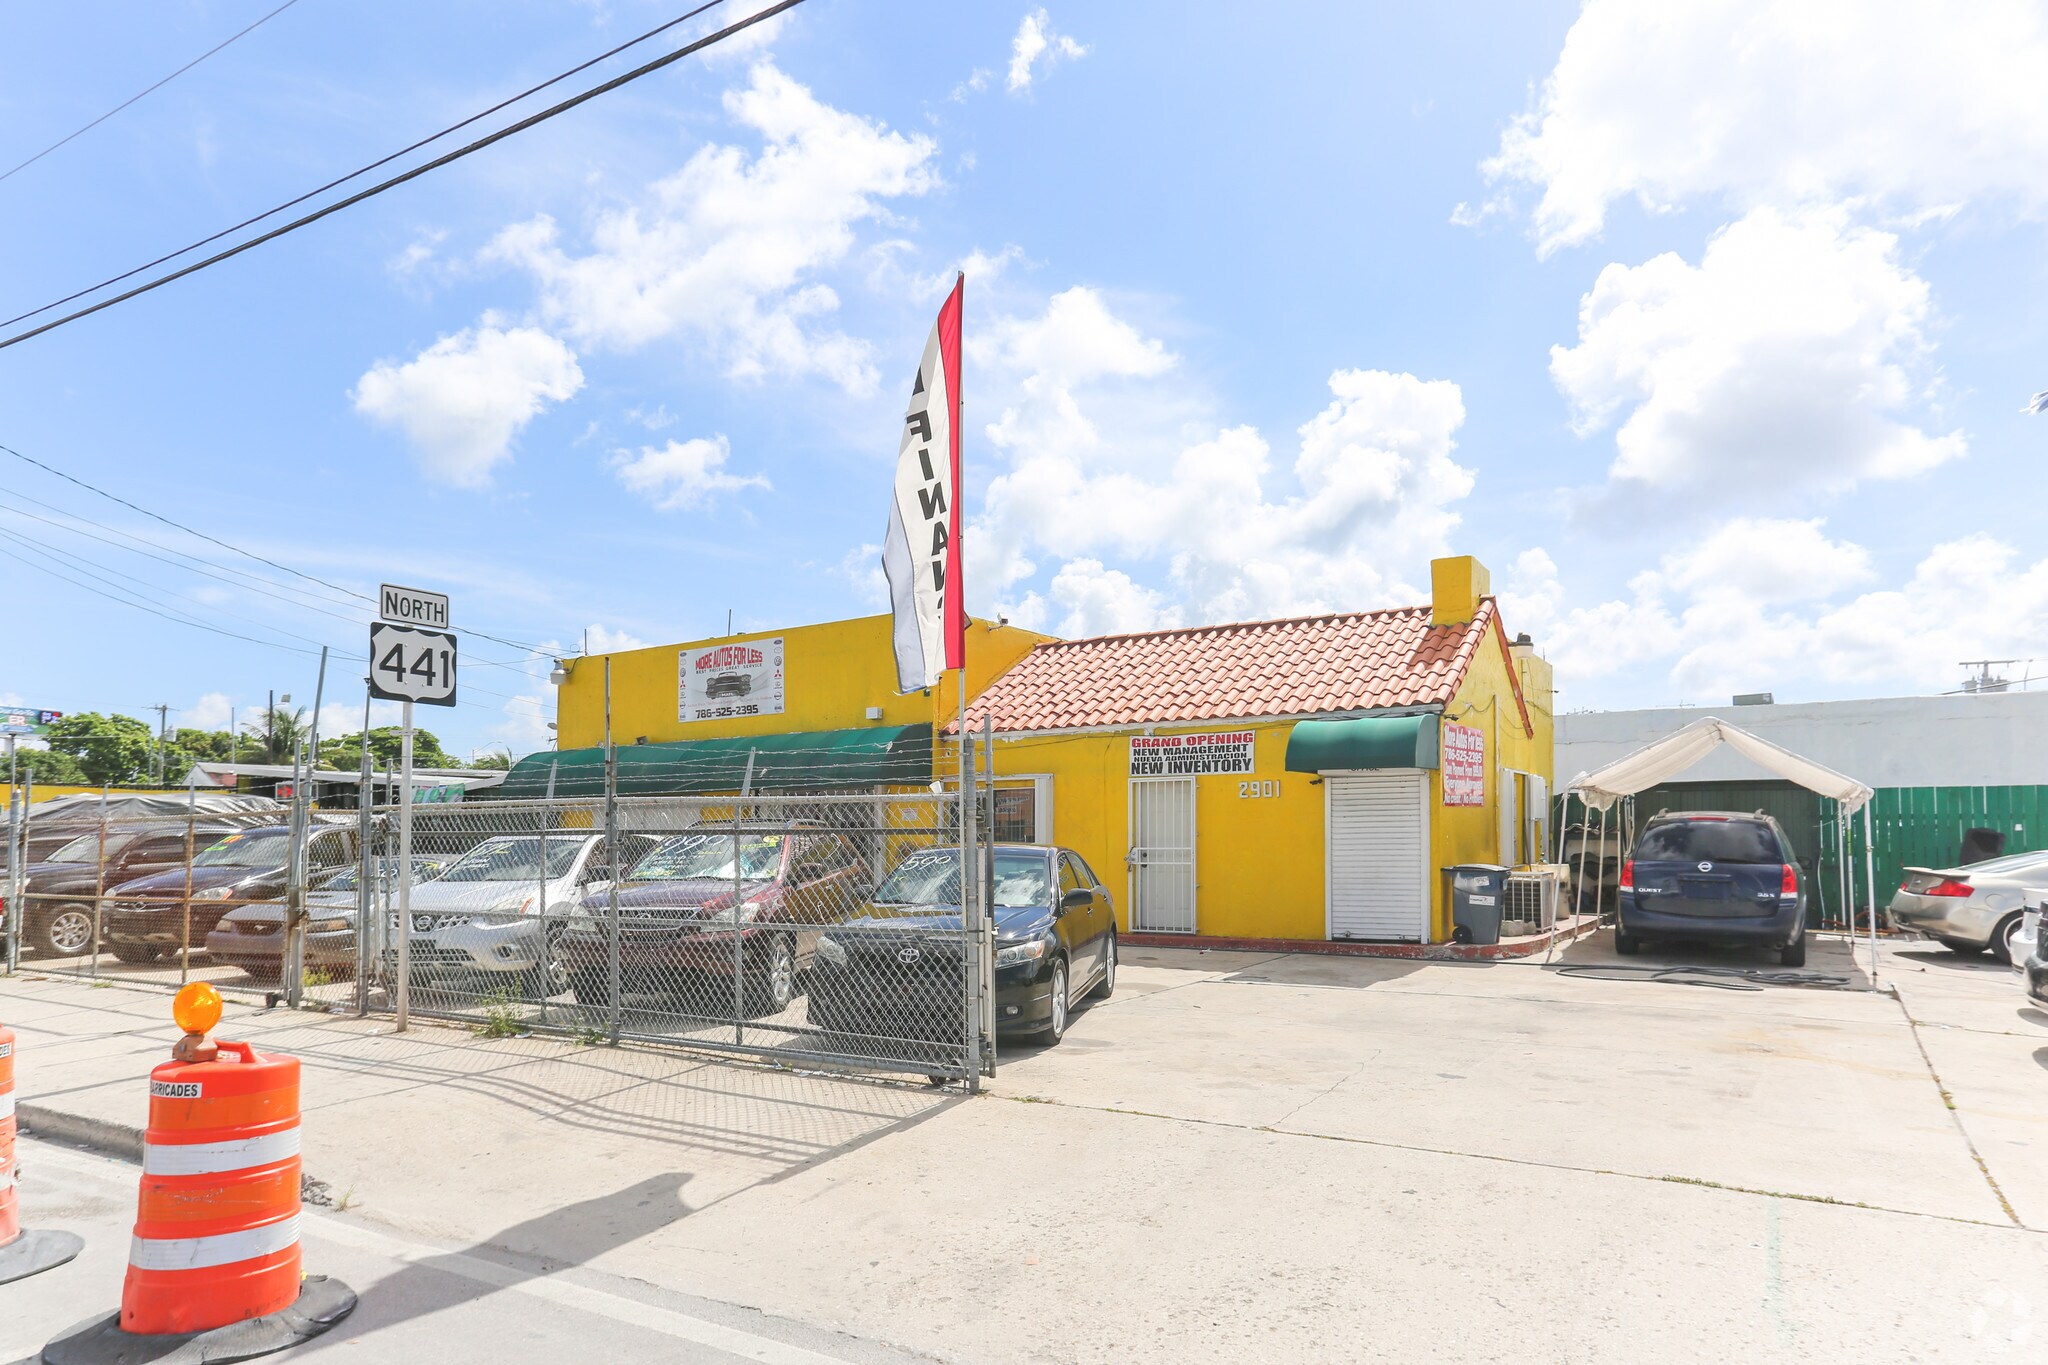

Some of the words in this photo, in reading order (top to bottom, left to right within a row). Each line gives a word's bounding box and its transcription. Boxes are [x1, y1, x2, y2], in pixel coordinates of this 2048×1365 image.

[385, 591, 444, 623] NORTH
[379, 642, 449, 688] 441
[695, 652, 712, 670] MORE
[713, 646, 733, 668] AUTOS
[733, 646, 746, 665] FOR
[747, 647, 763, 663] LESS
[695, 704, 759, 719] 786-525-2395
[1131, 737, 1181, 748] GRAND
[1186, 732, 1254, 745] OPENING
[1133, 747, 1160, 757] NEW
[1163, 743, 1249, 756] MANAGEMENT
[1445, 748, 1482, 764] 786-525-2395
[1131, 761, 1164, 775] NEW
[1167, 758, 1252, 774] INVENTORY
[1134, 755, 1163, 763] NUEVA
[1239, 780, 1281, 798] 2901
